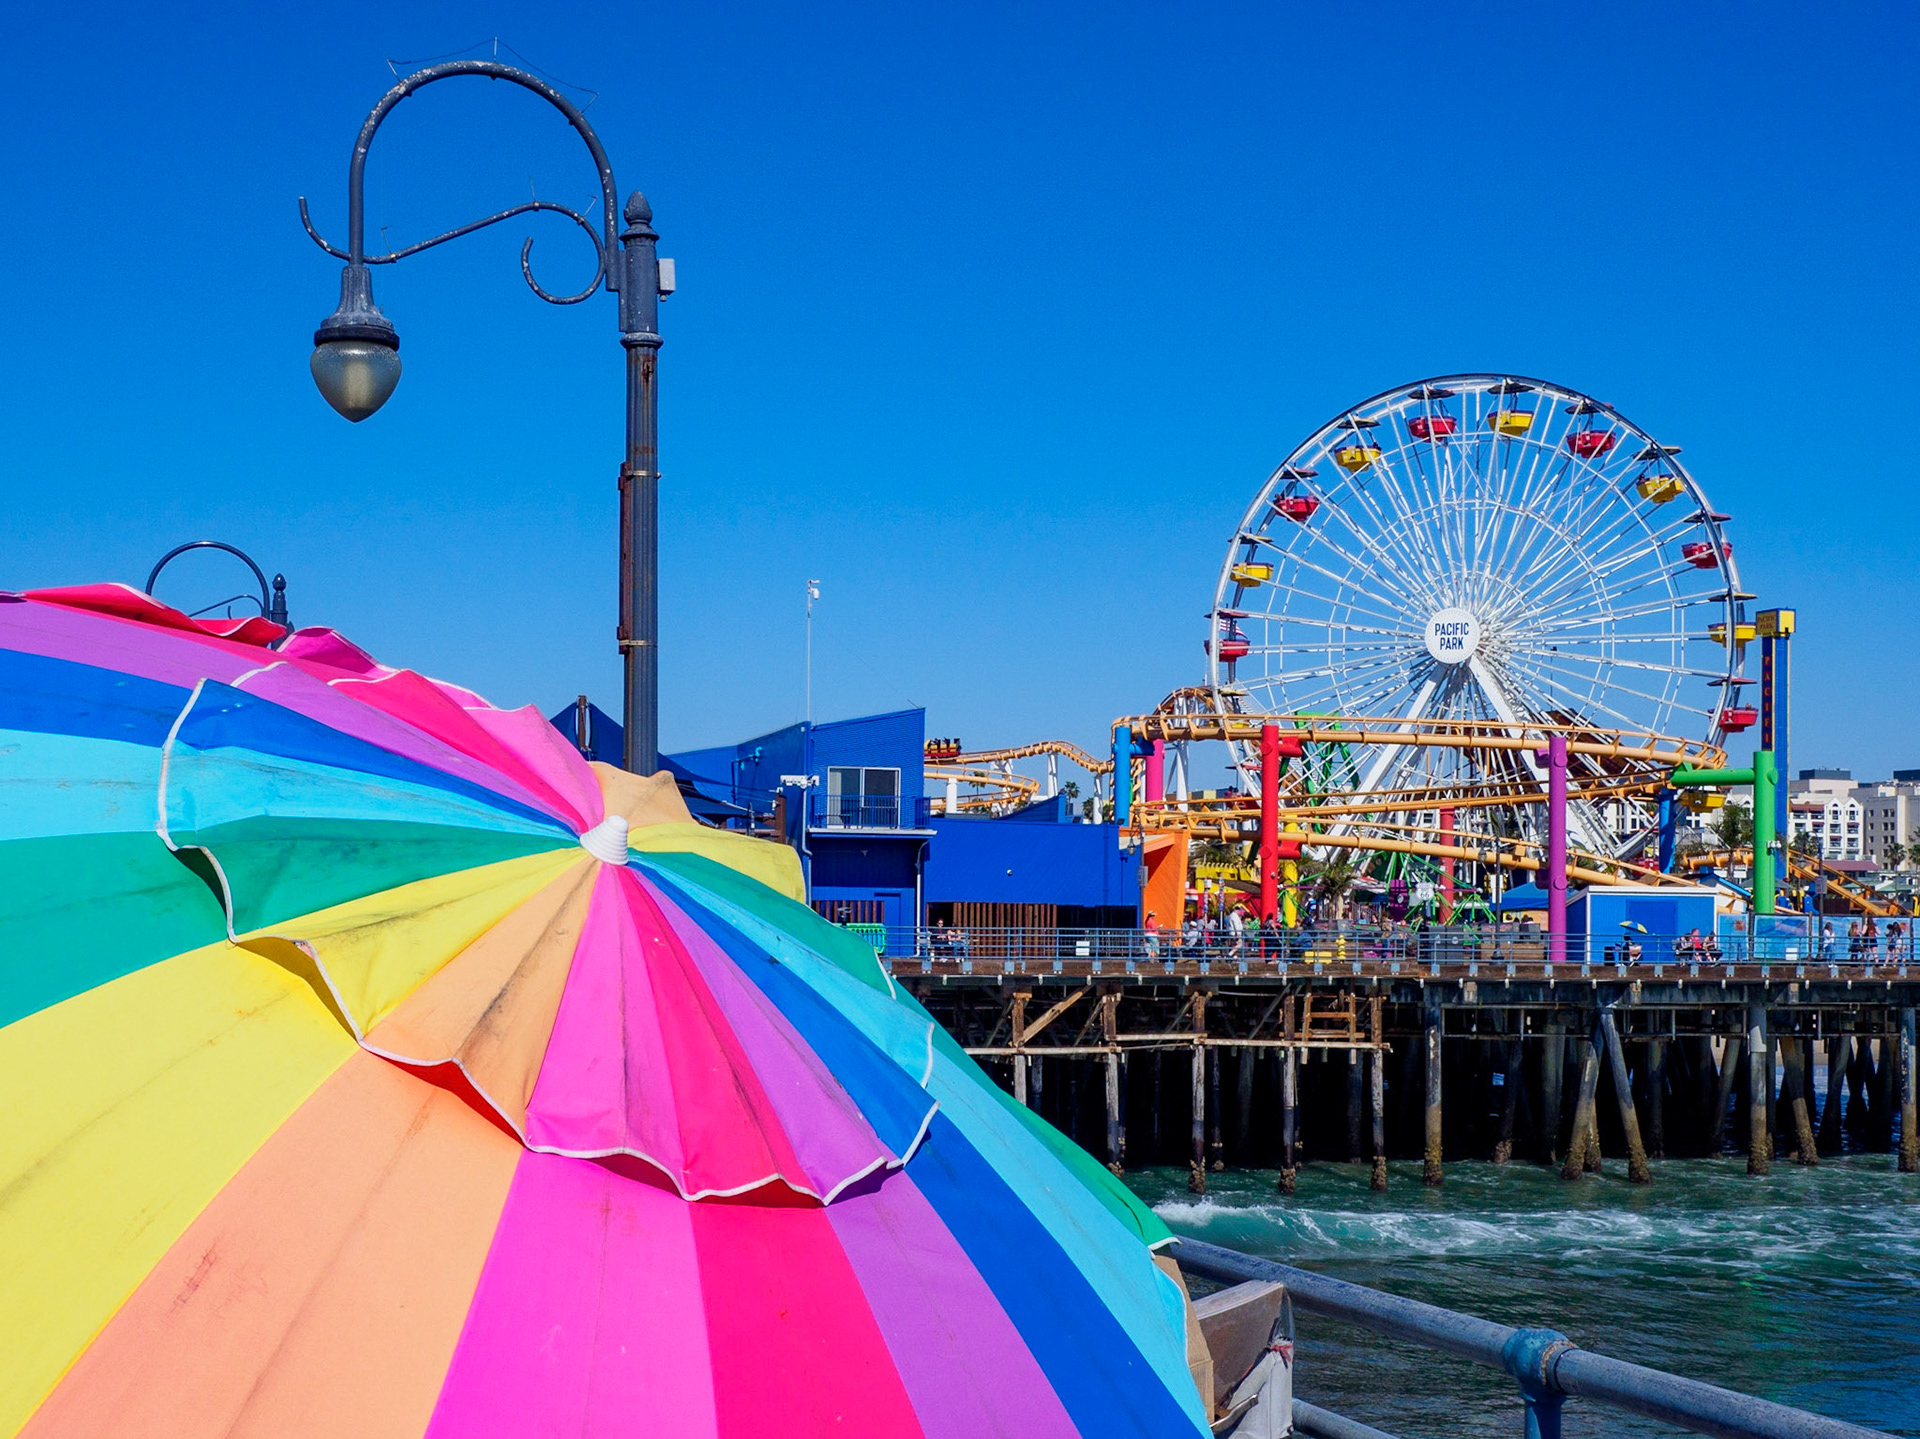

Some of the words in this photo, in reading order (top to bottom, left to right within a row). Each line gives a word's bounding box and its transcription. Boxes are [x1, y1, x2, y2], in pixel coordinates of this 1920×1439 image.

[1435, 622, 1469, 636] PACIFIC
[1440, 637, 1464, 650] PARK
[1420, 890, 1430, 898] 66
